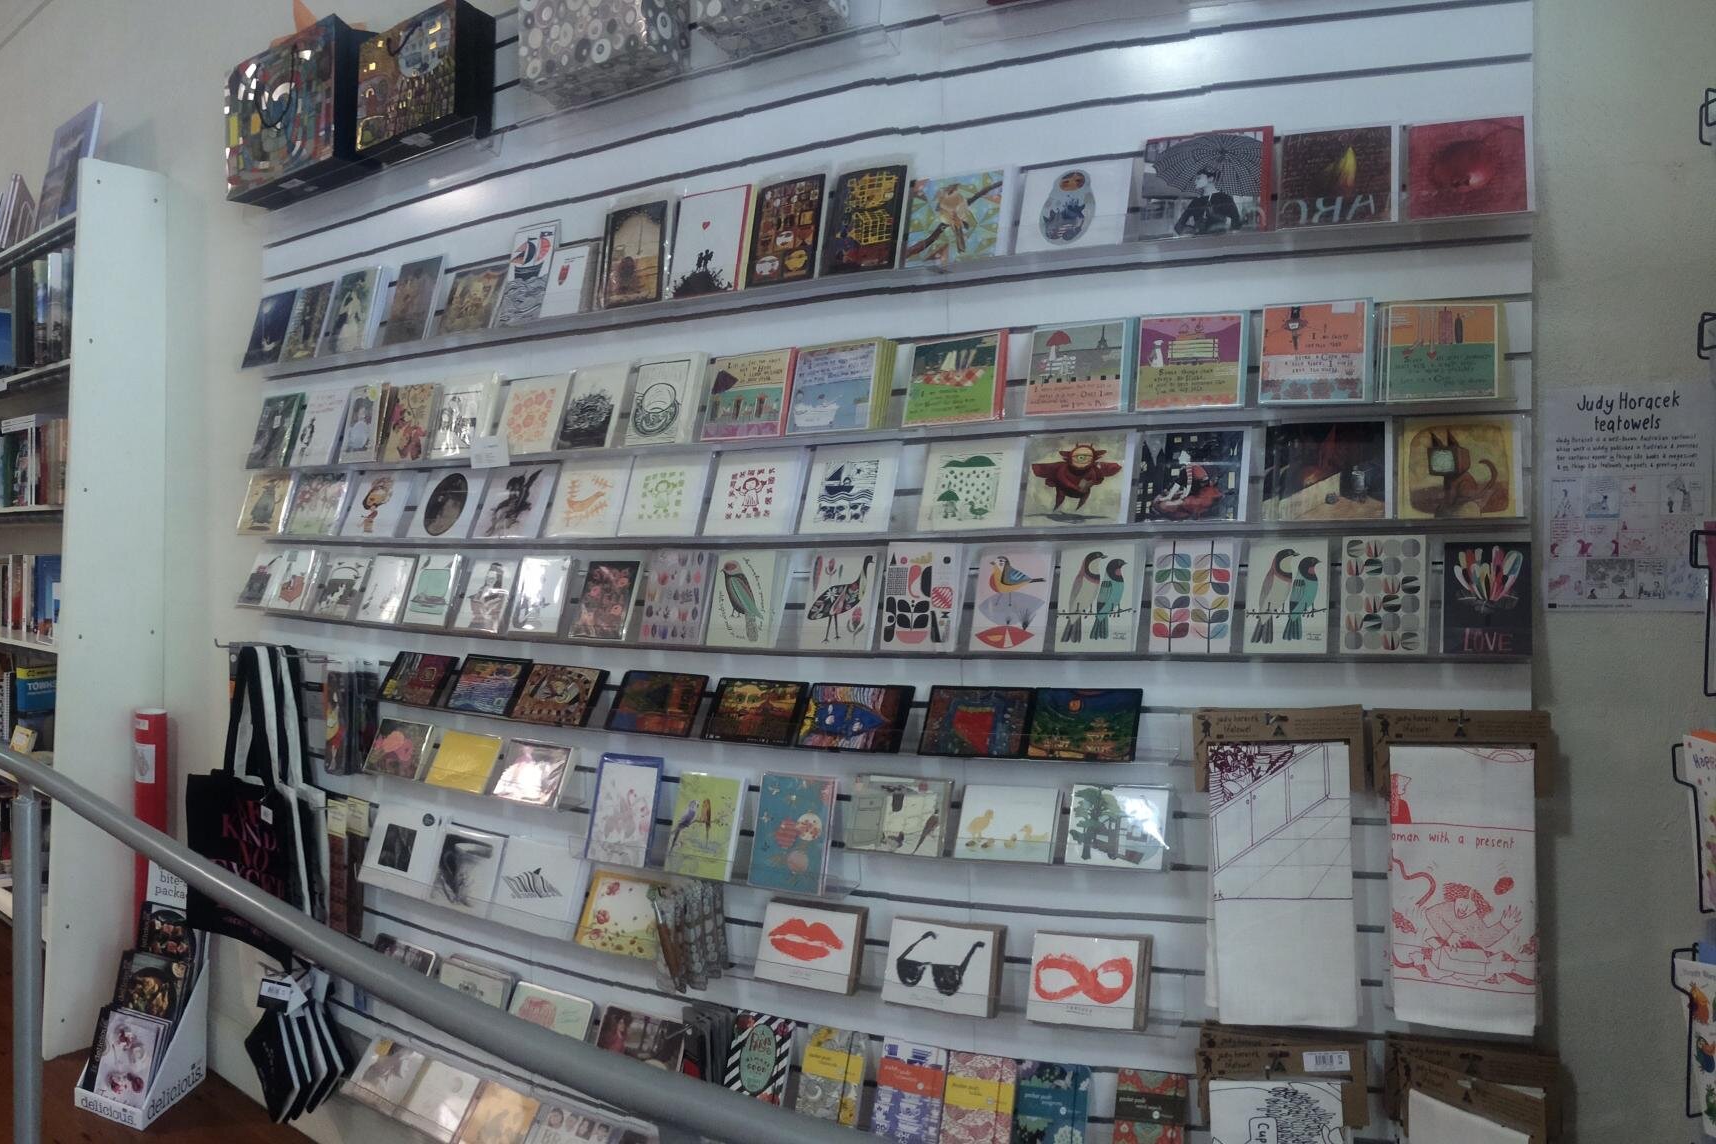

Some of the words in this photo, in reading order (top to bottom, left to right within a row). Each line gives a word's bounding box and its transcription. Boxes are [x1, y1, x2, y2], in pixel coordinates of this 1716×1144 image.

[1576, 394, 1615, 415] Judy
[1619, 389, 1681, 410] Horacek
[1594, 413, 1662, 433] teatowels
[1463, 627, 1514, 651] LOVE
[1428, 830, 1450, 844] with
[1457, 833, 1465, 844] a
[1475, 834, 1516, 849] present
[147, 1068, 204, 1121] delicious.
[80, 1096, 136, 1128] delicious.
[1255, 1122, 1270, 1144] Cup
